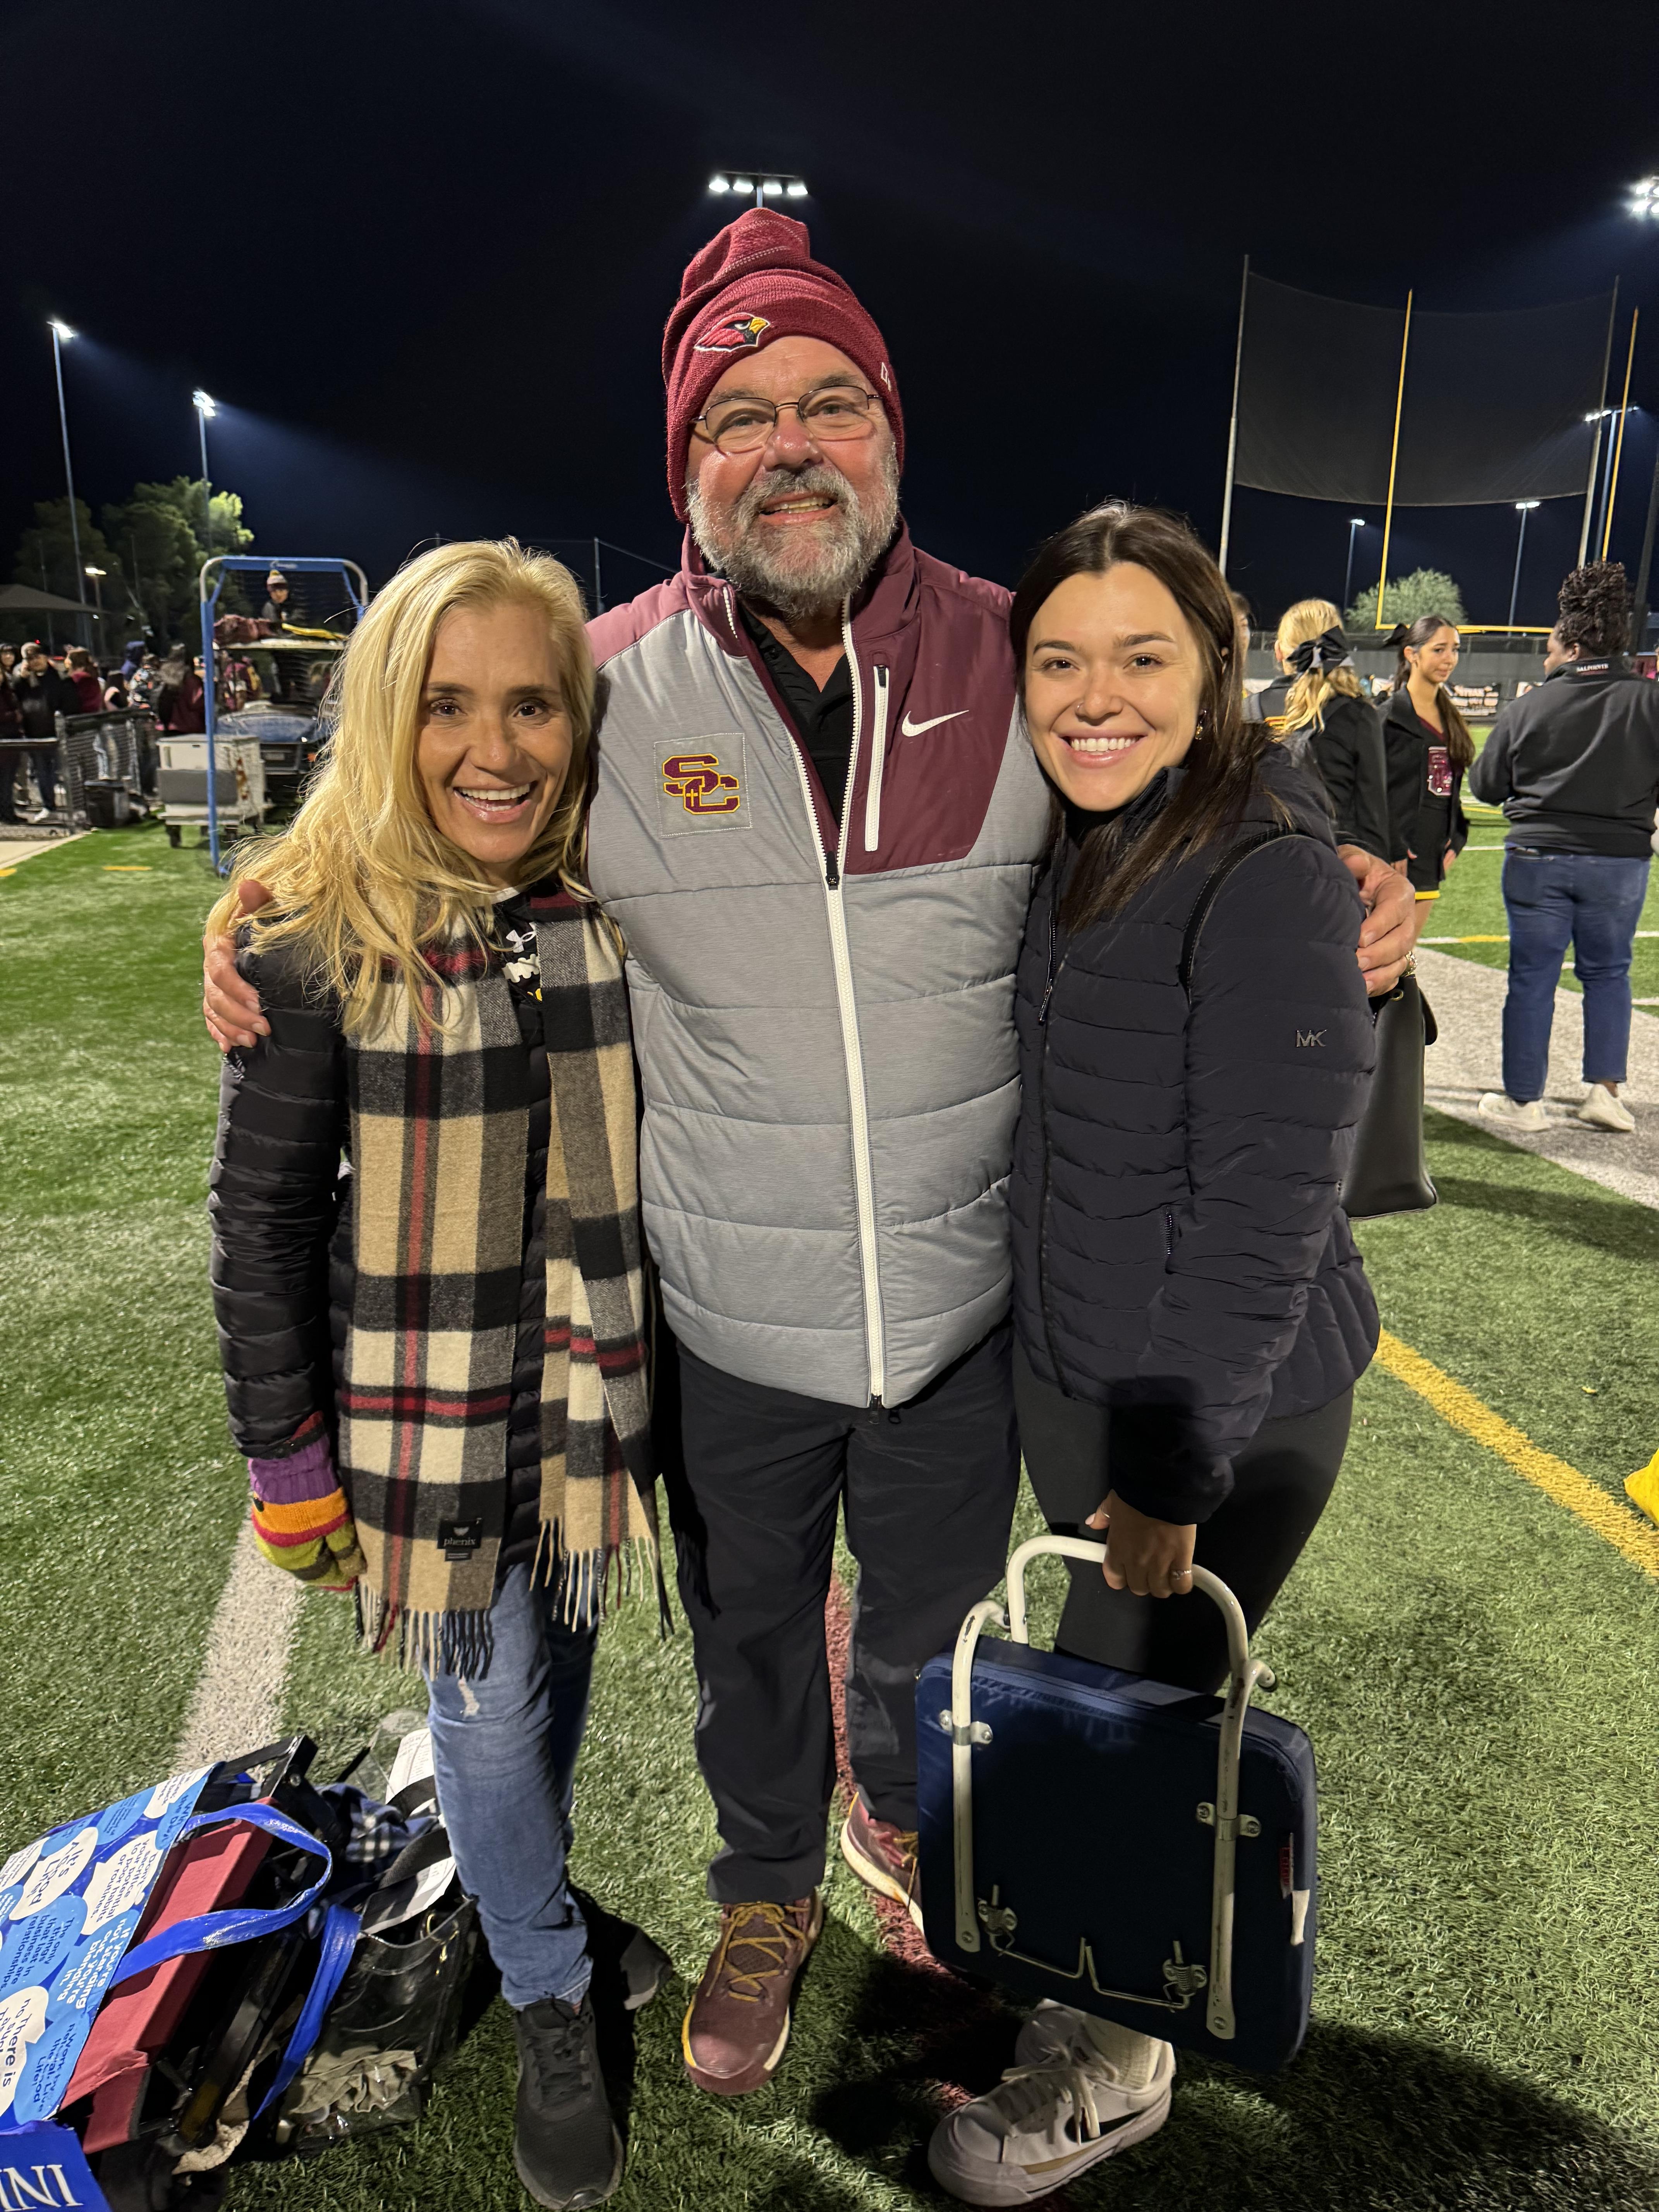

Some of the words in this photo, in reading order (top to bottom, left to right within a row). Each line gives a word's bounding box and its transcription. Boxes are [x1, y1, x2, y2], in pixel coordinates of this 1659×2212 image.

[663, 753, 740, 815] SC
[1296, 1030, 1327, 1047] MK
[443, 1537, 476, 1547] phenix
[118, 1854, 126, 1865] or
[131, 1843, 141, 1855] to
[134, 1839, 150, 1864] your
[28, 1855, 70, 1907] Good
[116, 1857, 134, 1883] poor
[124, 1851, 150, 1898] sacrifice
[137, 1852, 158, 1887] Don't
[90, 1869, 120, 1918] routines.
[96, 1886, 120, 1922] habits
[106, 1867, 136, 1918] potential
[21, 1915, 50, 1963] business
[40, 1917, 58, 1941] that
[59, 1917, 75, 1939] The
[109, 1918, 127, 1943] not
[120, 1927, 132, 1939] If
[30, 1943, 46, 1964] last
[39, 1927, 62, 1962] things
[44, 1941, 60, 1964] only
[93, 1930, 113, 1958] out,
[11, 1966, 24, 1985] are
[23, 1965, 35, 1977] in
[57, 1940, 101, 2001] blending
[97, 1941, 124, 1987] you're
[59, 1968, 77, 1986] in.
[66, 1960, 98, 2004] you're
[76, 1945, 113, 2009] standing
[15, 1998, 31, 2018] no
[5, 2013, 33, 2066] There
[46, 2023, 76, 2079] Refal.
[47, 2038, 62, 2059] the
[3, 2071, 16, 2087] is
